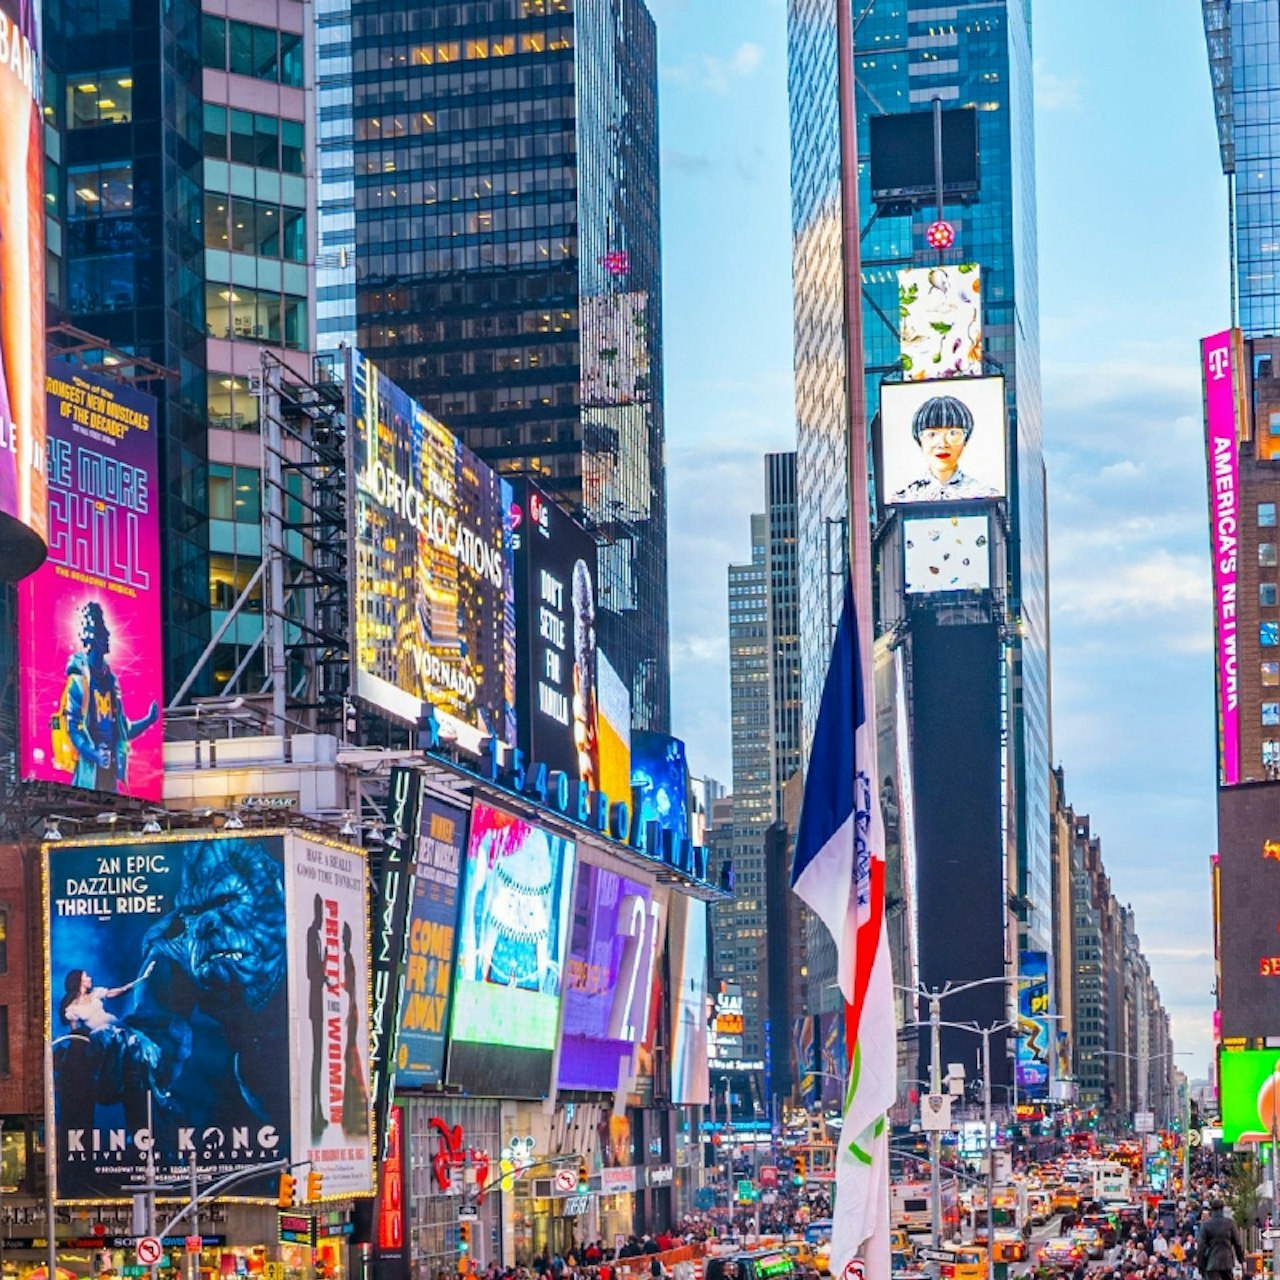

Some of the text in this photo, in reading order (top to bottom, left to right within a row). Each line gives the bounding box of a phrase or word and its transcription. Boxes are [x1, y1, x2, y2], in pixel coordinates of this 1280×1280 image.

[60, 401, 89, 426] OF THE
[87, 391, 150, 432] NEW MUSICALS
[78, 446, 148, 514] MORE
[373, 461, 424, 531] OFFICE
[427, 501, 503, 589] LOCATIONS
[1214, 436, 1237, 574] AMERICA'S
[411, 644, 476, 702] VORNADO
[56, 896, 112, 916] THRILL
[67, 876, 149, 896] DAZZLING
[323, 898, 341, 997] PRETTY
[410, 917, 454, 960] COME
[403, 998, 447, 1034] AWAY
[327, 1016, 345, 1125] WOMAN
[68, 1126, 279, 1153] KING KONG
[68, 1151, 122, 1162] ALIVE
